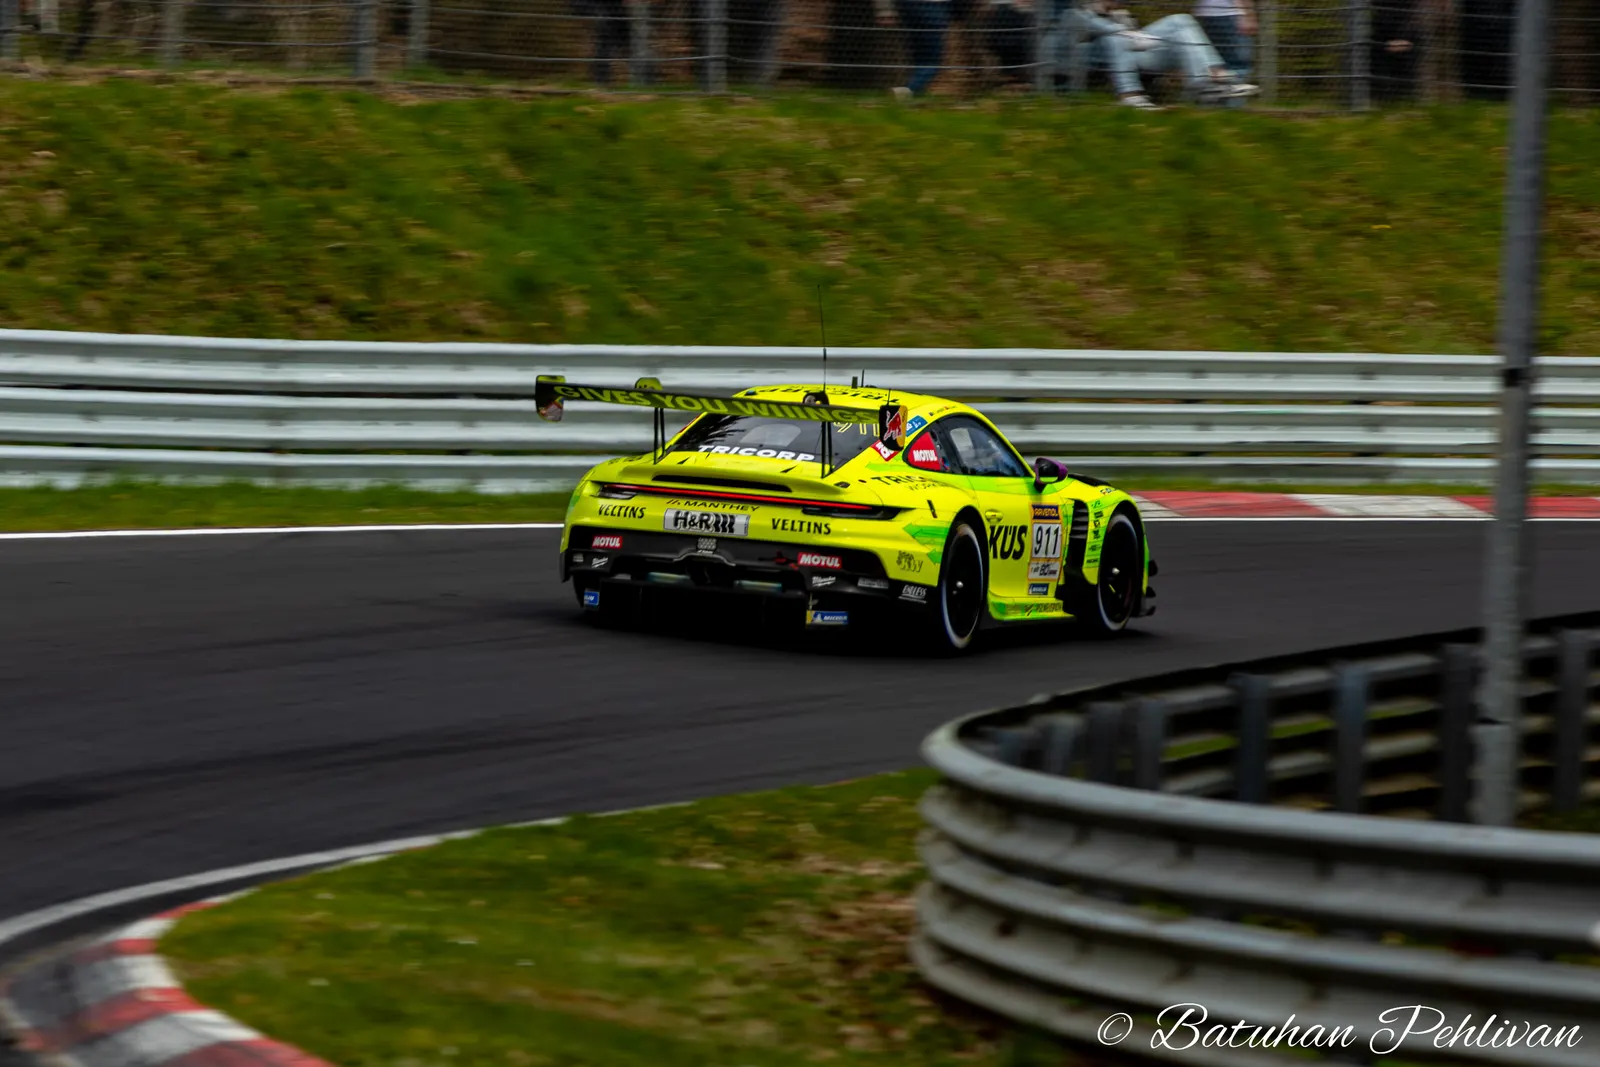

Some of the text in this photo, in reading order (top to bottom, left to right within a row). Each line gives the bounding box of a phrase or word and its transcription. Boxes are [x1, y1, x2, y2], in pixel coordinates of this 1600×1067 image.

[553, 385, 651, 406] GIVES
[651, 393, 728, 413] YOU
[698, 445, 815, 461] TRICORP
[912, 449, 938, 462] MOTUL
[598, 504, 647, 519] VELTINS
[684, 500, 760, 512] MANTHEY
[771, 518, 832, 535] VELTINS
[592, 536, 621, 548] MOTUL
[1034, 525, 1060, 557] 911
[800, 554, 841, 568] MOTUL
